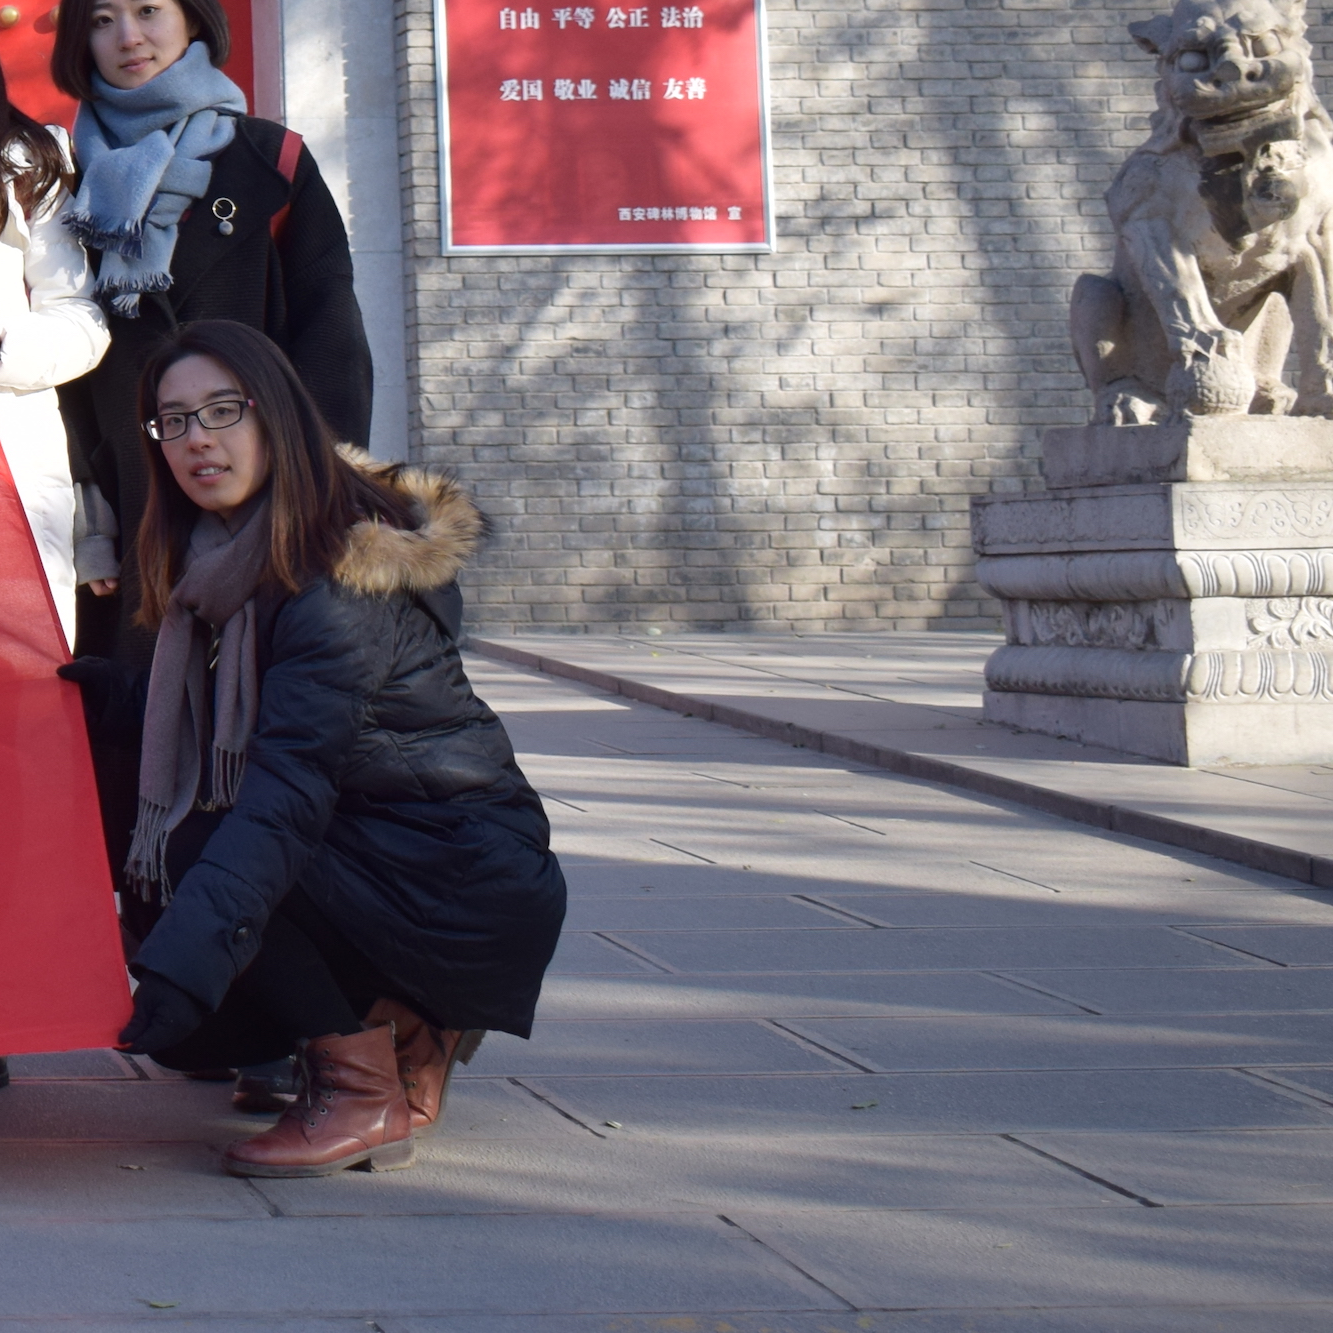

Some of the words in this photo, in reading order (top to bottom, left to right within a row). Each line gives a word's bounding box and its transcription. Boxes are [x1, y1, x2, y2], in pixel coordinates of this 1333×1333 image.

[499, 7, 540, 30] 自由
[552, 7, 595, 29] 平等
[606, 6, 649, 28] 公正
[660, 6, 704, 28] 法治
[499, 79, 543, 101] 爱国
[553, 78, 597, 100] 敬业
[608, 78, 651, 100] 诚信
[663, 77, 707, 99] 友善
[618, 207, 717, 221] 西安碑林博物馆
[727, 206, 742, 220] 宣
